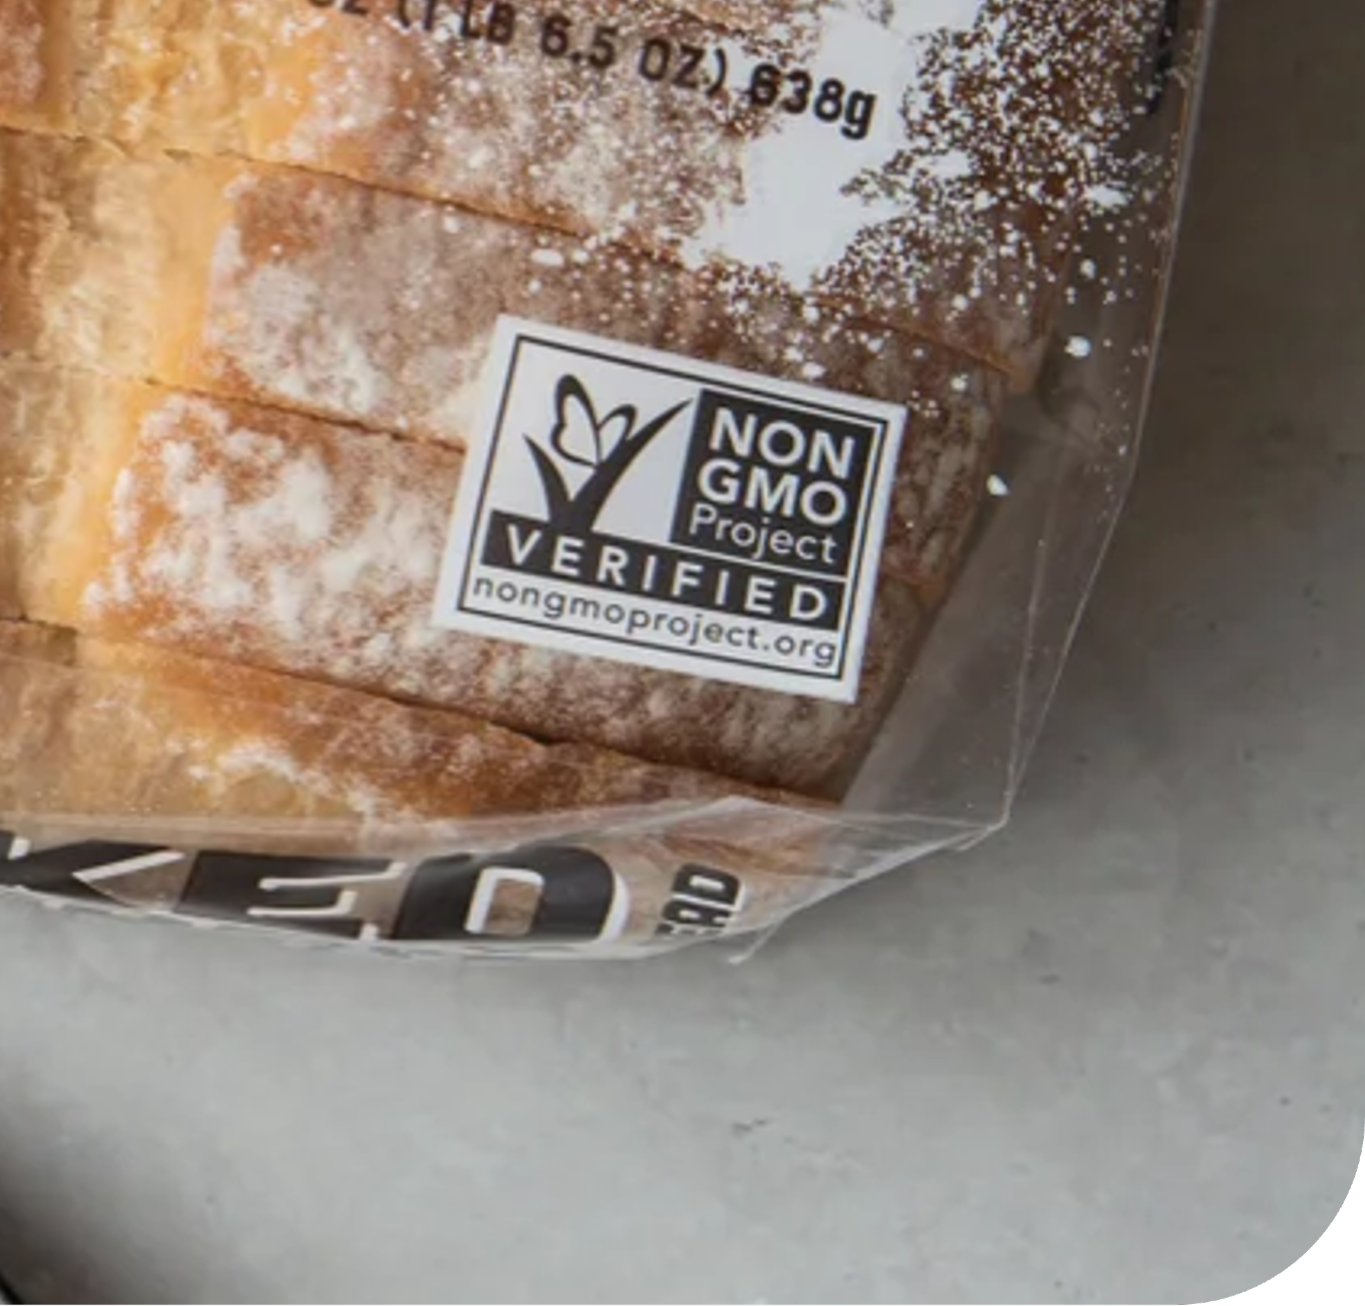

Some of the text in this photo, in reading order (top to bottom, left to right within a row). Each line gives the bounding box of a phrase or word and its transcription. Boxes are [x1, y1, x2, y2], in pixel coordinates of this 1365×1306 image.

[540, 14, 618, 70] 6.5
[639, 37, 728, 97] OZ)
[749, 63, 877, 140] 638g
[709, 407, 855, 479] NON
[697, 459, 847, 526] GMO
[506, 526, 827, 622] VERIFIED
[688, 502, 838, 566] Project
[472, 576, 838, 668] nongmoproject.org
